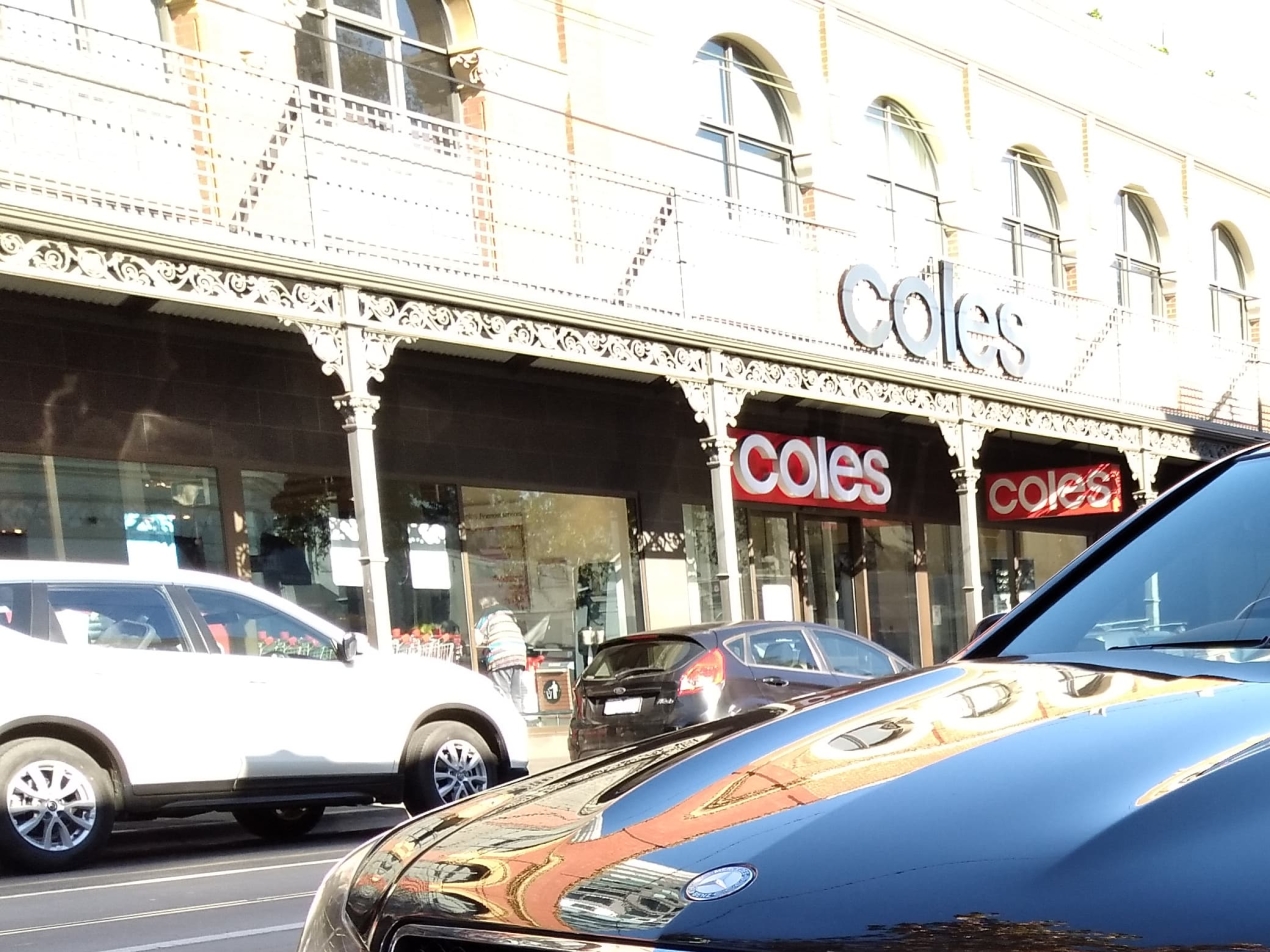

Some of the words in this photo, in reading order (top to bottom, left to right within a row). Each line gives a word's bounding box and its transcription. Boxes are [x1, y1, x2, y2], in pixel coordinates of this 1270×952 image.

[839, 260, 1031, 378] coles
[735, 432, 893, 506] coles
[988, 464, 1112, 514] coles
